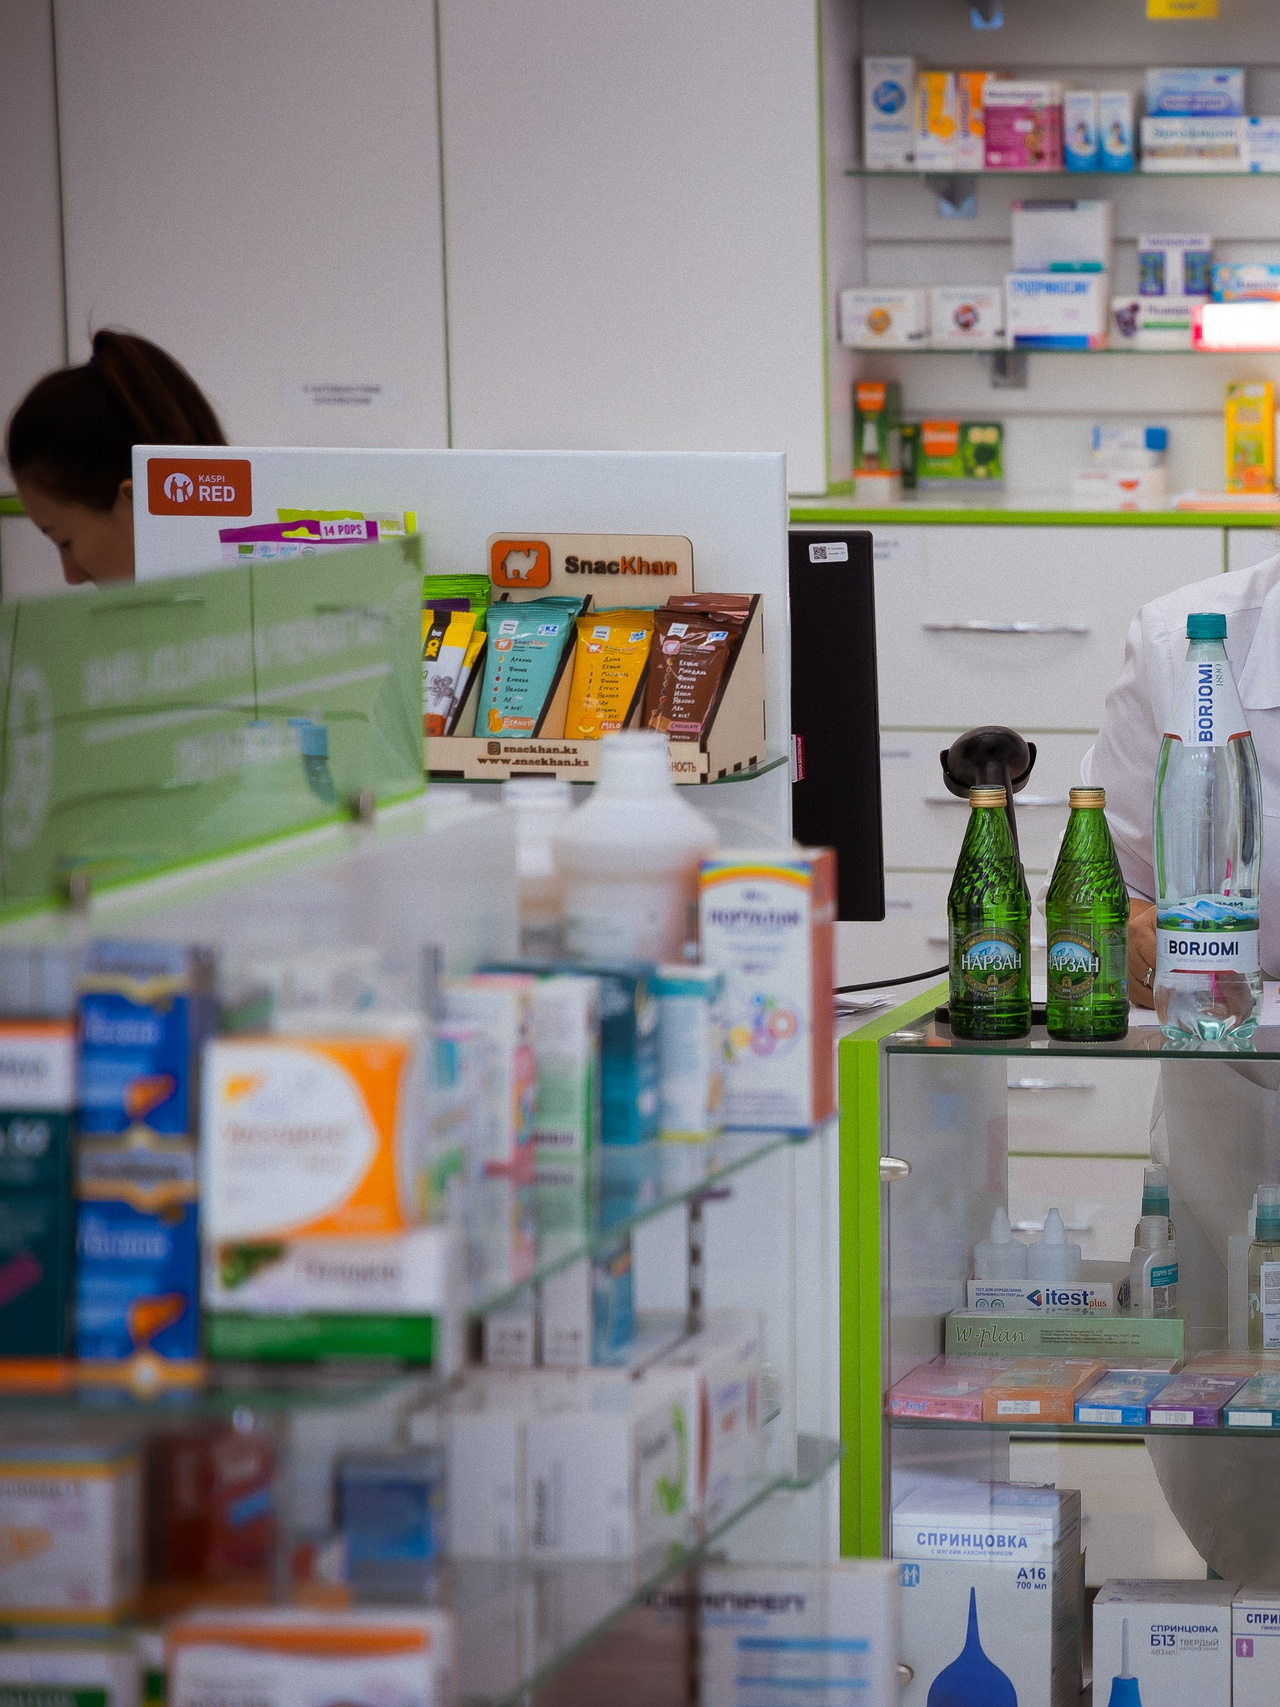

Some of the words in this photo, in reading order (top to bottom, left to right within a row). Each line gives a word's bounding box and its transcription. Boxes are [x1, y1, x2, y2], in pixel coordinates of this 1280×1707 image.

[198, 474, 226, 483] KASPI
[199, 485, 236, 502] RED
[323, 525, 336, 537] 14
[337, 523, 363, 536] POPS
[564, 555, 677, 576] SnacKhan
[545, 625, 558, 633] KZ
[1215, 663, 1224, 687] 1890
[1198, 663, 1213, 742] BORJOMI
[503, 745, 578, 755] snackhan.kz
[477, 757, 590, 768] www.snackhan.kz
[1169, 940, 1239, 956] BORJOMI
[961, 953, 1022, 971] НАРЗАН
[1045, 1288, 1089, 1306] itest
[1089, 1299, 1107, 1309] plus
[955, 1324, 1030, 1349] W-plan
[916, 1532, 1029, 1550] СПРИНЦОВКА
[962, 1549, 1013, 1557] НАКОНЕЧНИКОМ
[1016, 1567, 1047, 1581] А16
[1016, 1581, 1032, 1590] 700
[1150, 1624, 1219, 1634] СПРИНЦОВКА
[1150, 1634, 1176, 1647] Б13
[1179, 1639, 1219, 1648] ТВЕРДЫЙ
